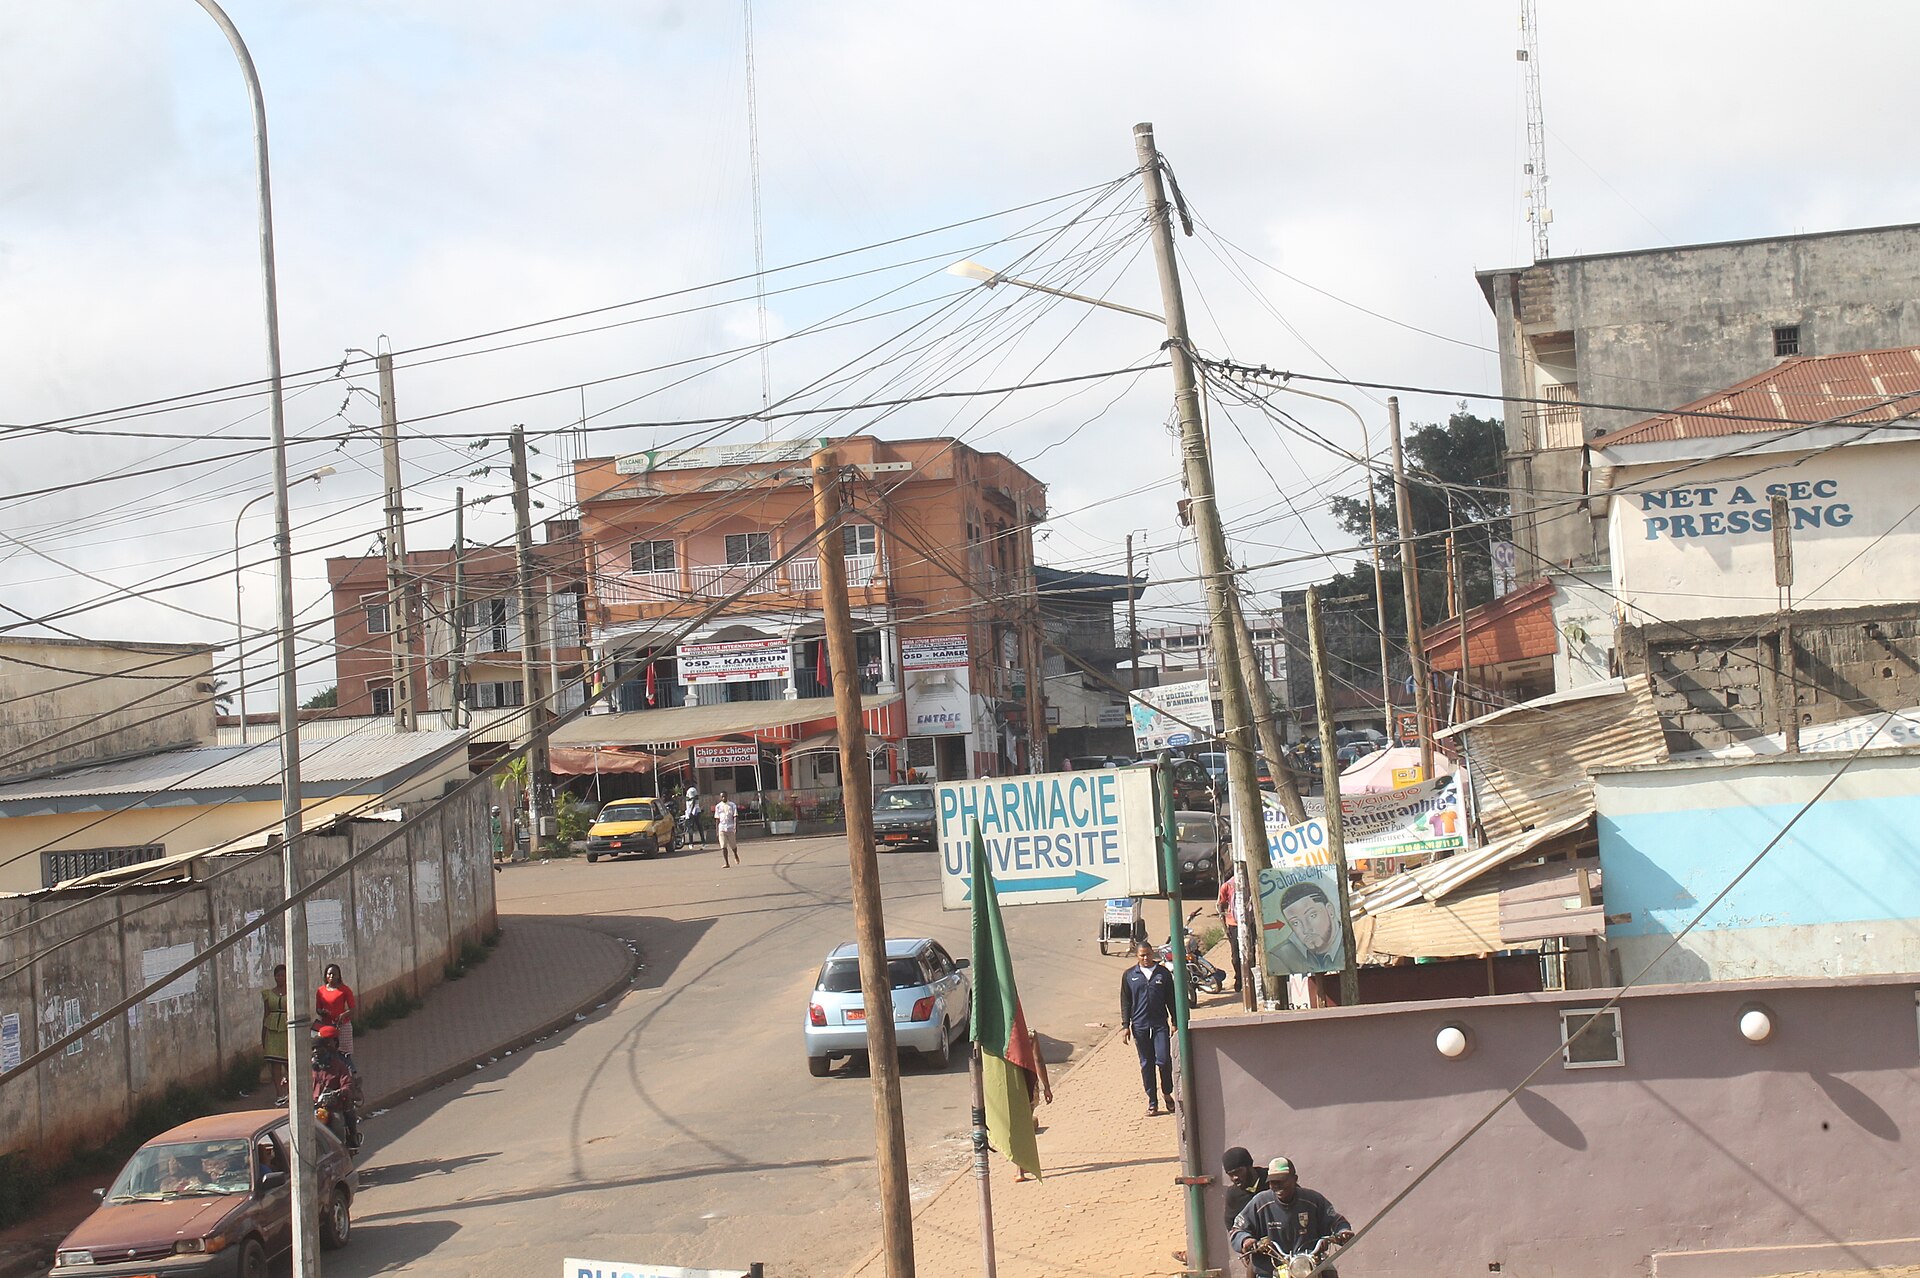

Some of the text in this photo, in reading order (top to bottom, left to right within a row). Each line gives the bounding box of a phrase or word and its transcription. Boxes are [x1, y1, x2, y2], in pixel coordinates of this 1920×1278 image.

[1640, 480, 1837, 510] NET A SEC
[1642, 504, 1853, 540] PRESSNG
[724, 656, 785, 664] KAMERUN
[1166, 696, 1208, 707] D'ANIMATION
[940, 775, 1118, 837] PHARMACIE
[1268, 822, 1323, 860] HOTO
[1260, 870, 1298, 899] Salon
